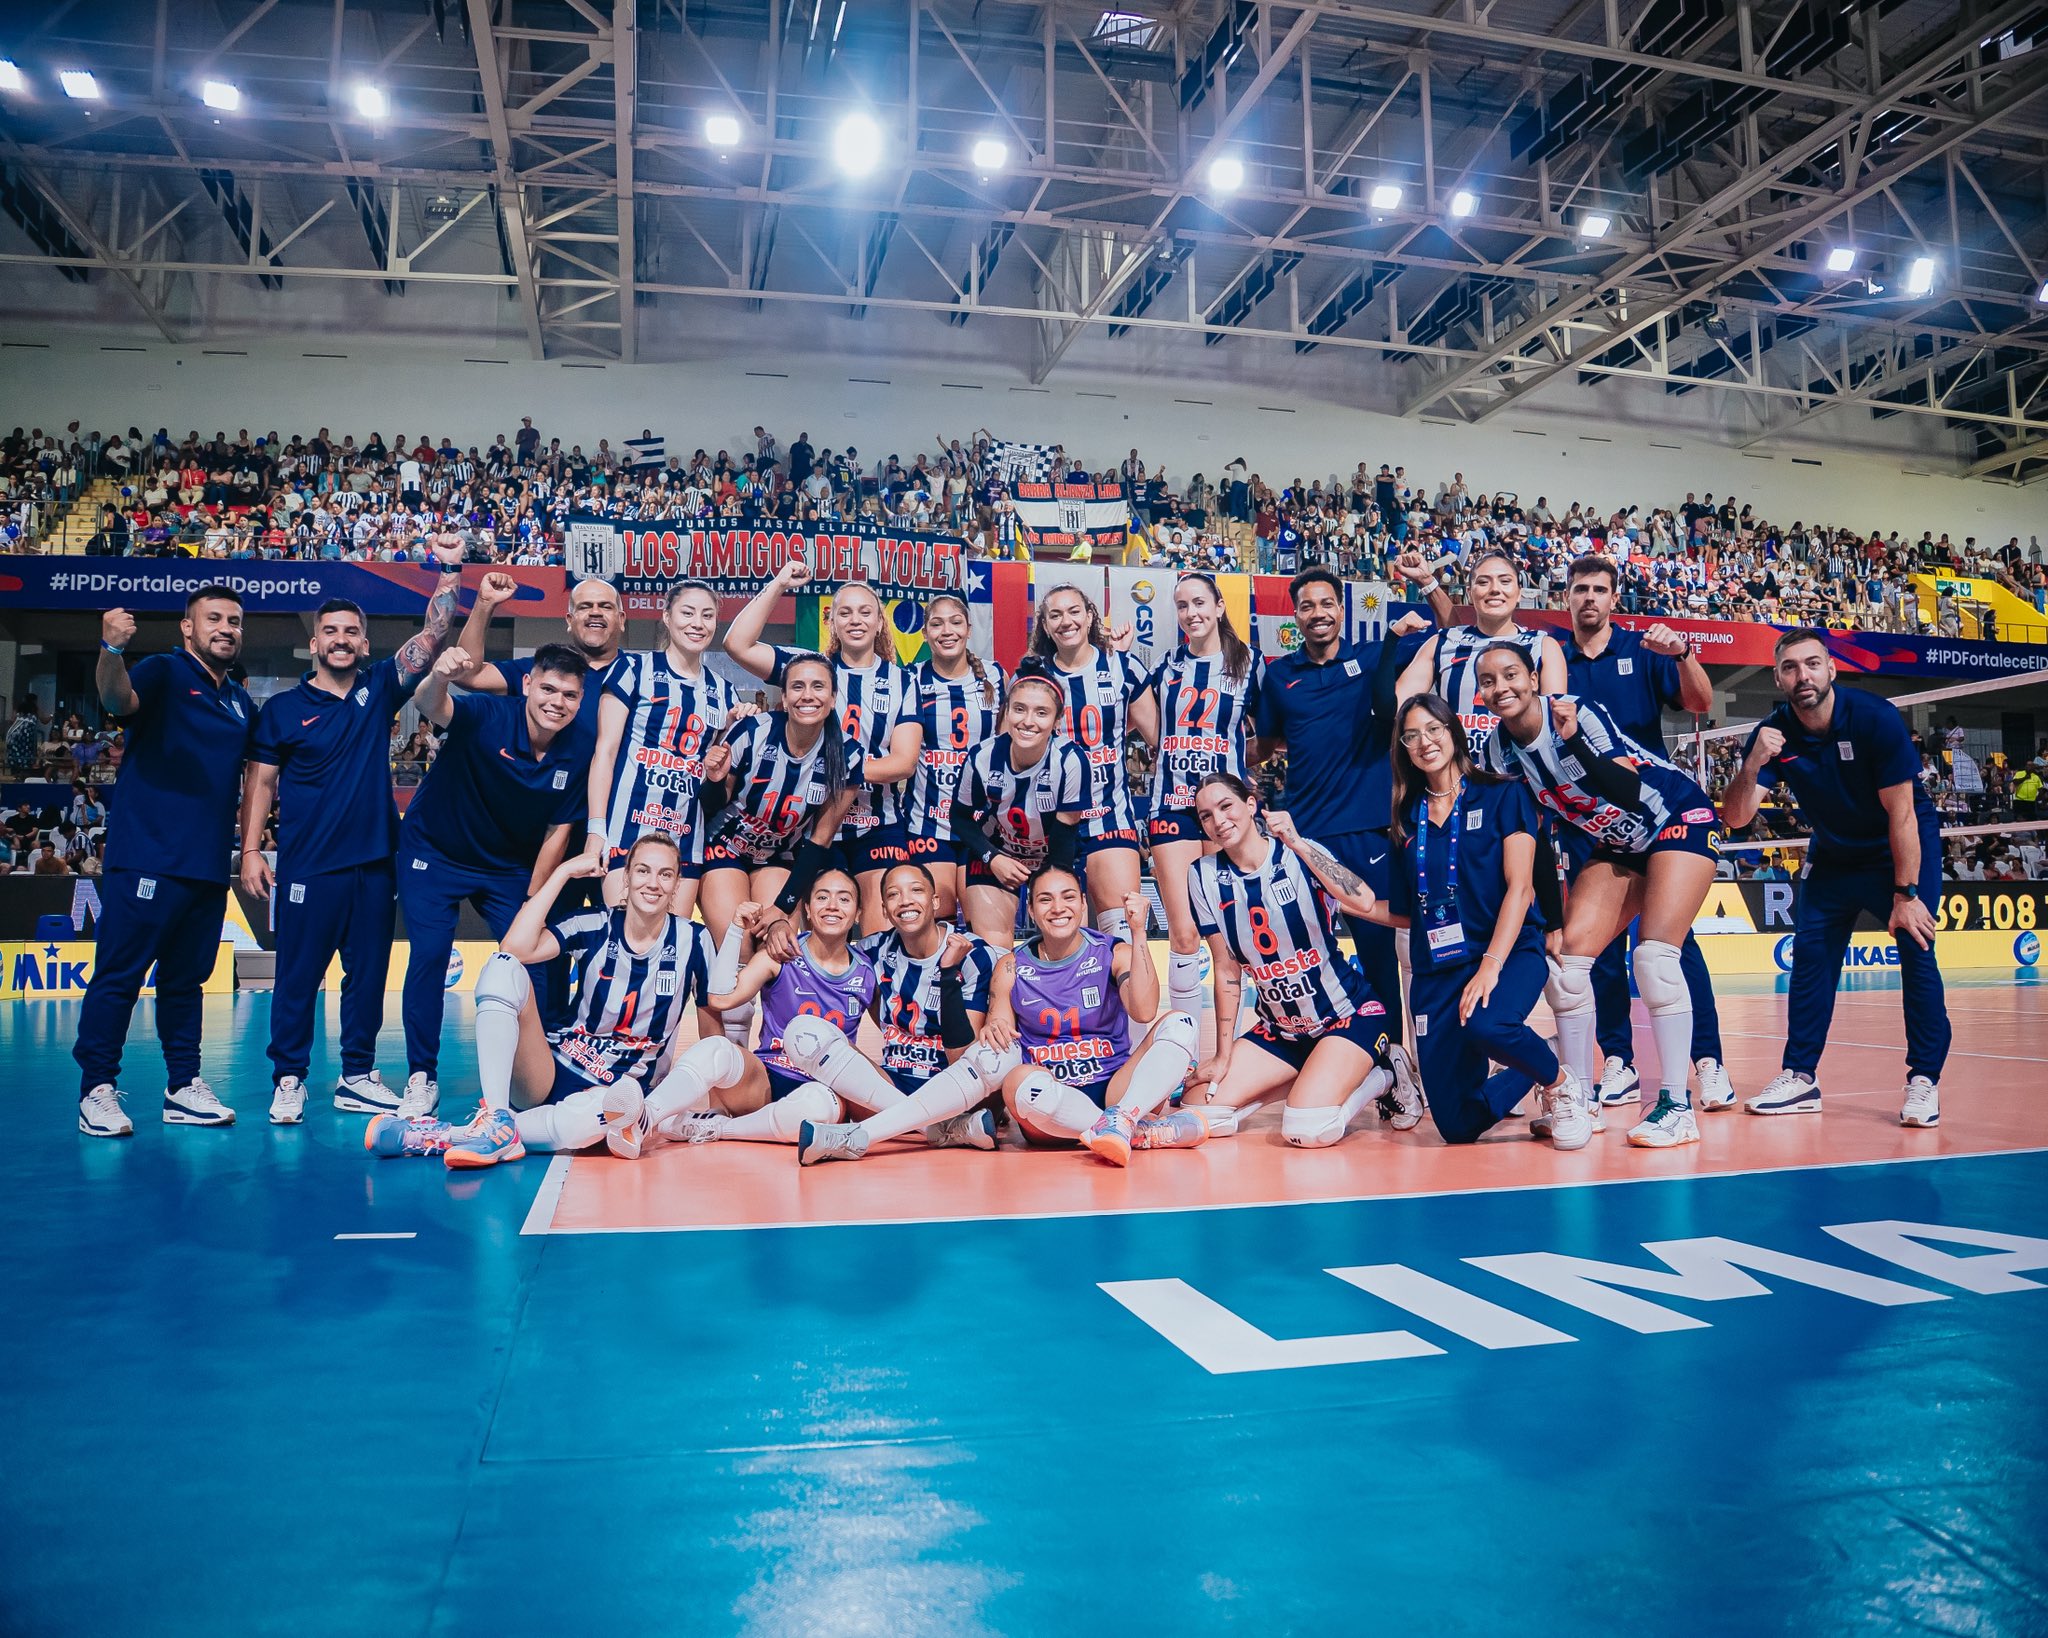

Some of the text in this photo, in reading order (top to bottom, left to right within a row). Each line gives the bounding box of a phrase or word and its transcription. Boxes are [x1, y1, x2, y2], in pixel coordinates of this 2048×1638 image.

[1018, 483, 1122, 499] BARRA ALIANZA LIMA
[676, 517, 887, 535] JUNTOS HASTA EL FINAL
[1042, 532, 1076, 545] AMIGOS
[623, 530, 680, 579] LOS
[688, 530, 806, 579] AMIGOS
[814, 534, 869, 583] DEL
[624, 582, 675, 591] PORQU
[628, 598, 653, 609] DEL
[1136, 605, 1154, 647] CSV
[1689, 632, 1734, 645] PERUANO
[842, 704, 862, 740] 6
[1177, 686, 1219, 730] 22
[660, 706, 705, 756] 18
[950, 707, 970, 749] 3
[1063, 704, 1102, 746] 10
[924, 750, 968, 768] apue
[1163, 736, 1230, 754] apuesta
[1171, 754, 1218, 773] total
[647, 768, 694, 797] total
[664, 808, 682, 820] Caja
[763, 790, 804, 834] 15
[1164, 794, 1196, 807] Huan
[632, 810, 692, 835] Huancayo
[843, 815, 880, 829] ncayo
[1007, 807, 1030, 840] 9
[1978, 894, 2036, 930] 108
[1248, 906, 1279, 956] 8
[1243, 948, 1322, 981] puesta
[1843, 946, 1901, 966] IKAS
[1076, 966, 1103, 978] HYUNDAI
[613, 991, 639, 1036] 1
[1039, 1006, 1082, 1044] 21
[1028, 1037, 1114, 1067] puesta
[1097, 1220, 2048, 1375] LIMA
